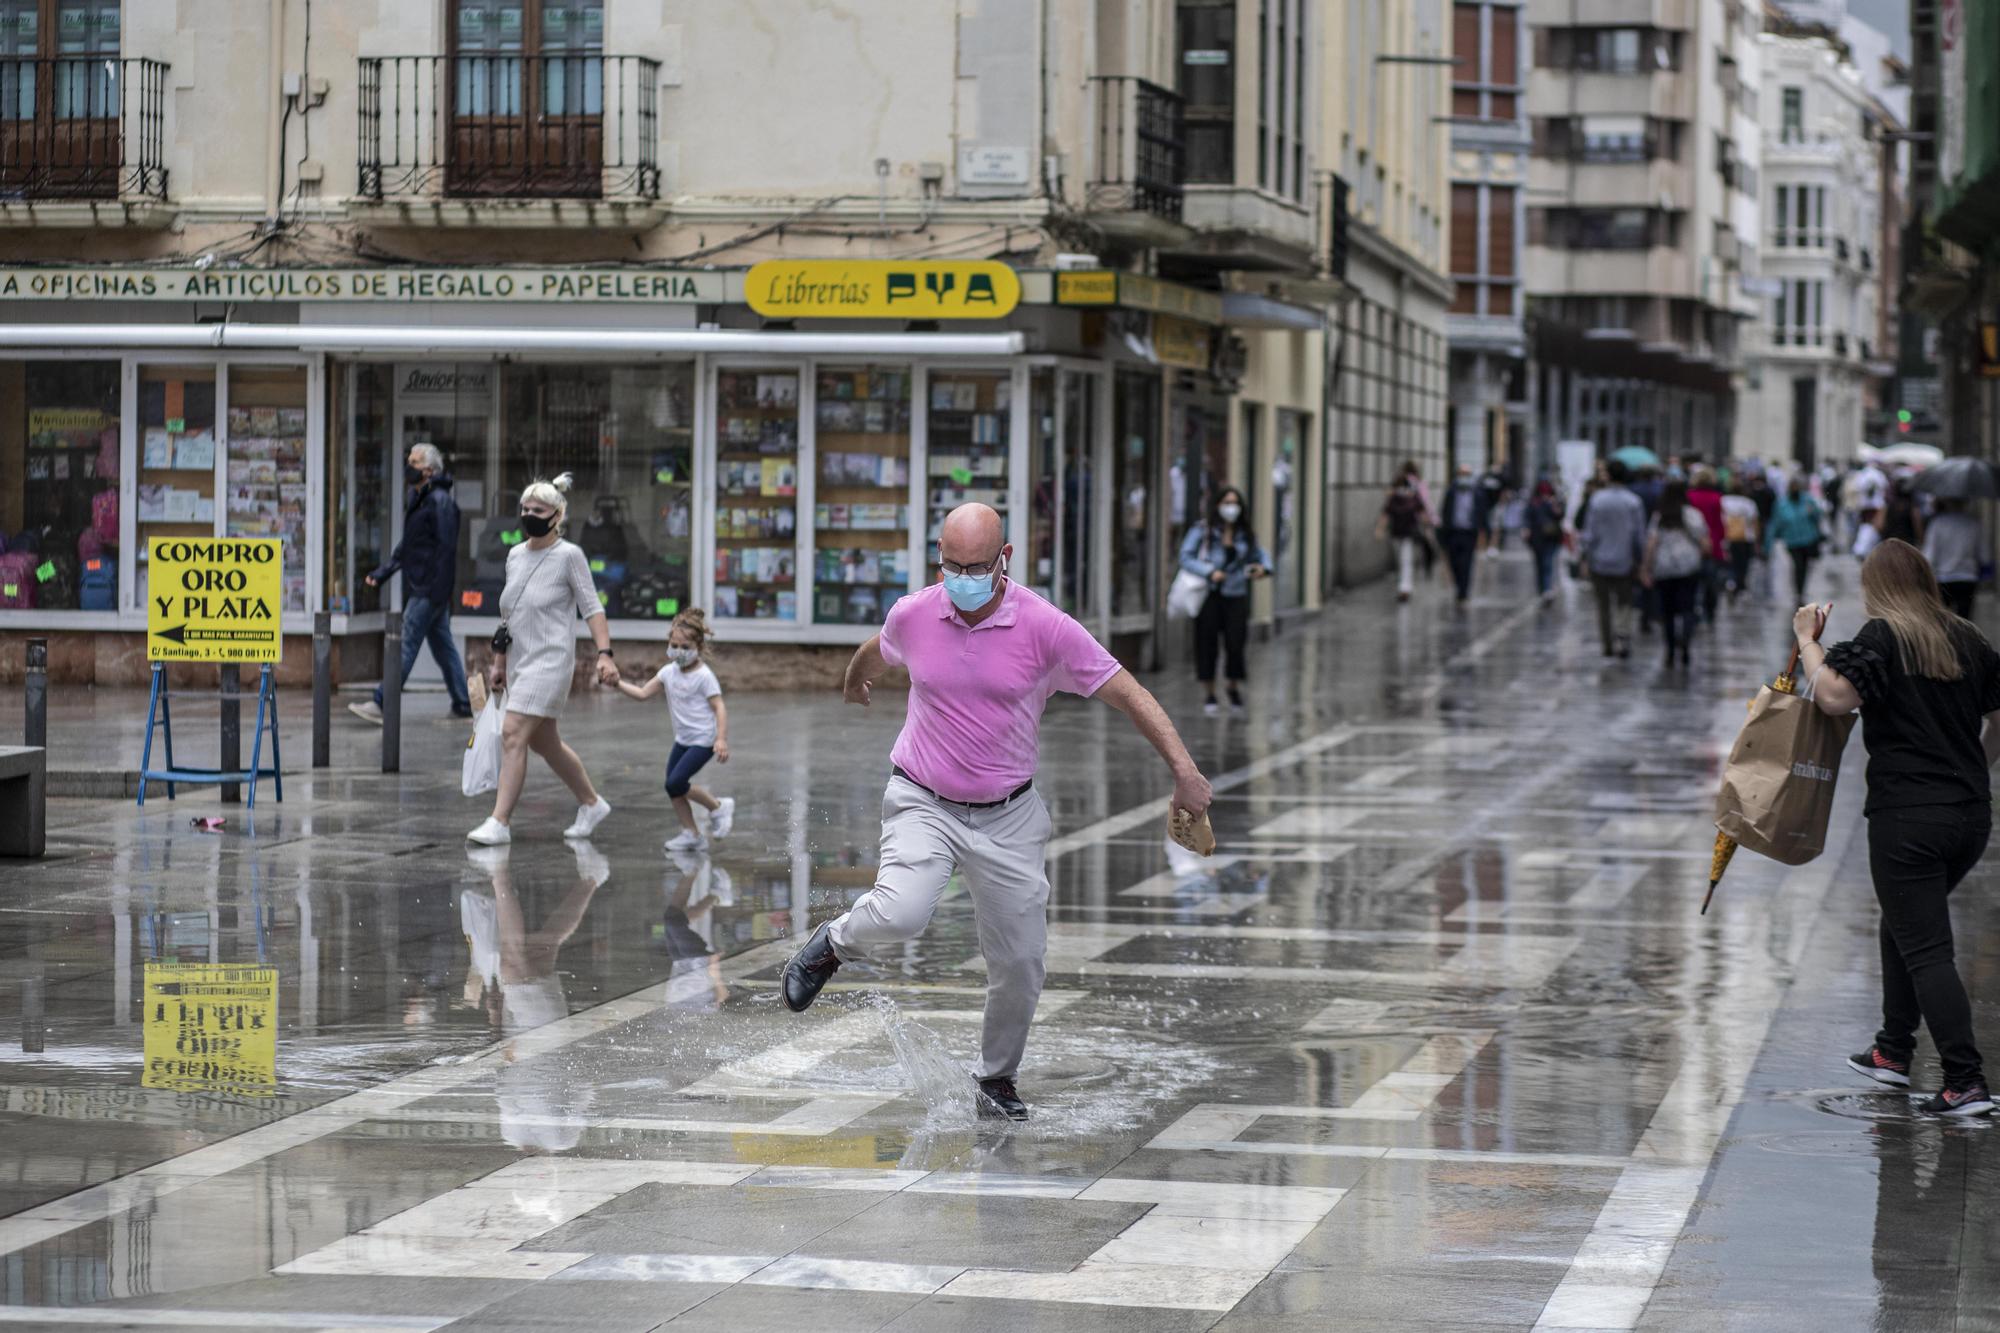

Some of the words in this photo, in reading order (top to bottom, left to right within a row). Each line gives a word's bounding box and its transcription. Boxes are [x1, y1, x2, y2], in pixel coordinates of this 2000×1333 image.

[3, 275, 19, 294] A
[31, 274, 157, 295] OFICINAS
[184, 274, 341, 296] ARTICULOS
[352, 274, 387, 296] DE
[399, 274, 514, 297] REGALO
[541, 275, 698, 297] PAPELERIA
[765, 270, 871, 304] Librerías
[887, 272, 997, 305] PYA
[155, 542, 274, 563] COMPRO
[181, 569, 247, 592] ORO
[155, 596, 174, 619] Y
[183, 597, 272, 620] PLATA
[151, 646, 160, 657] C/
